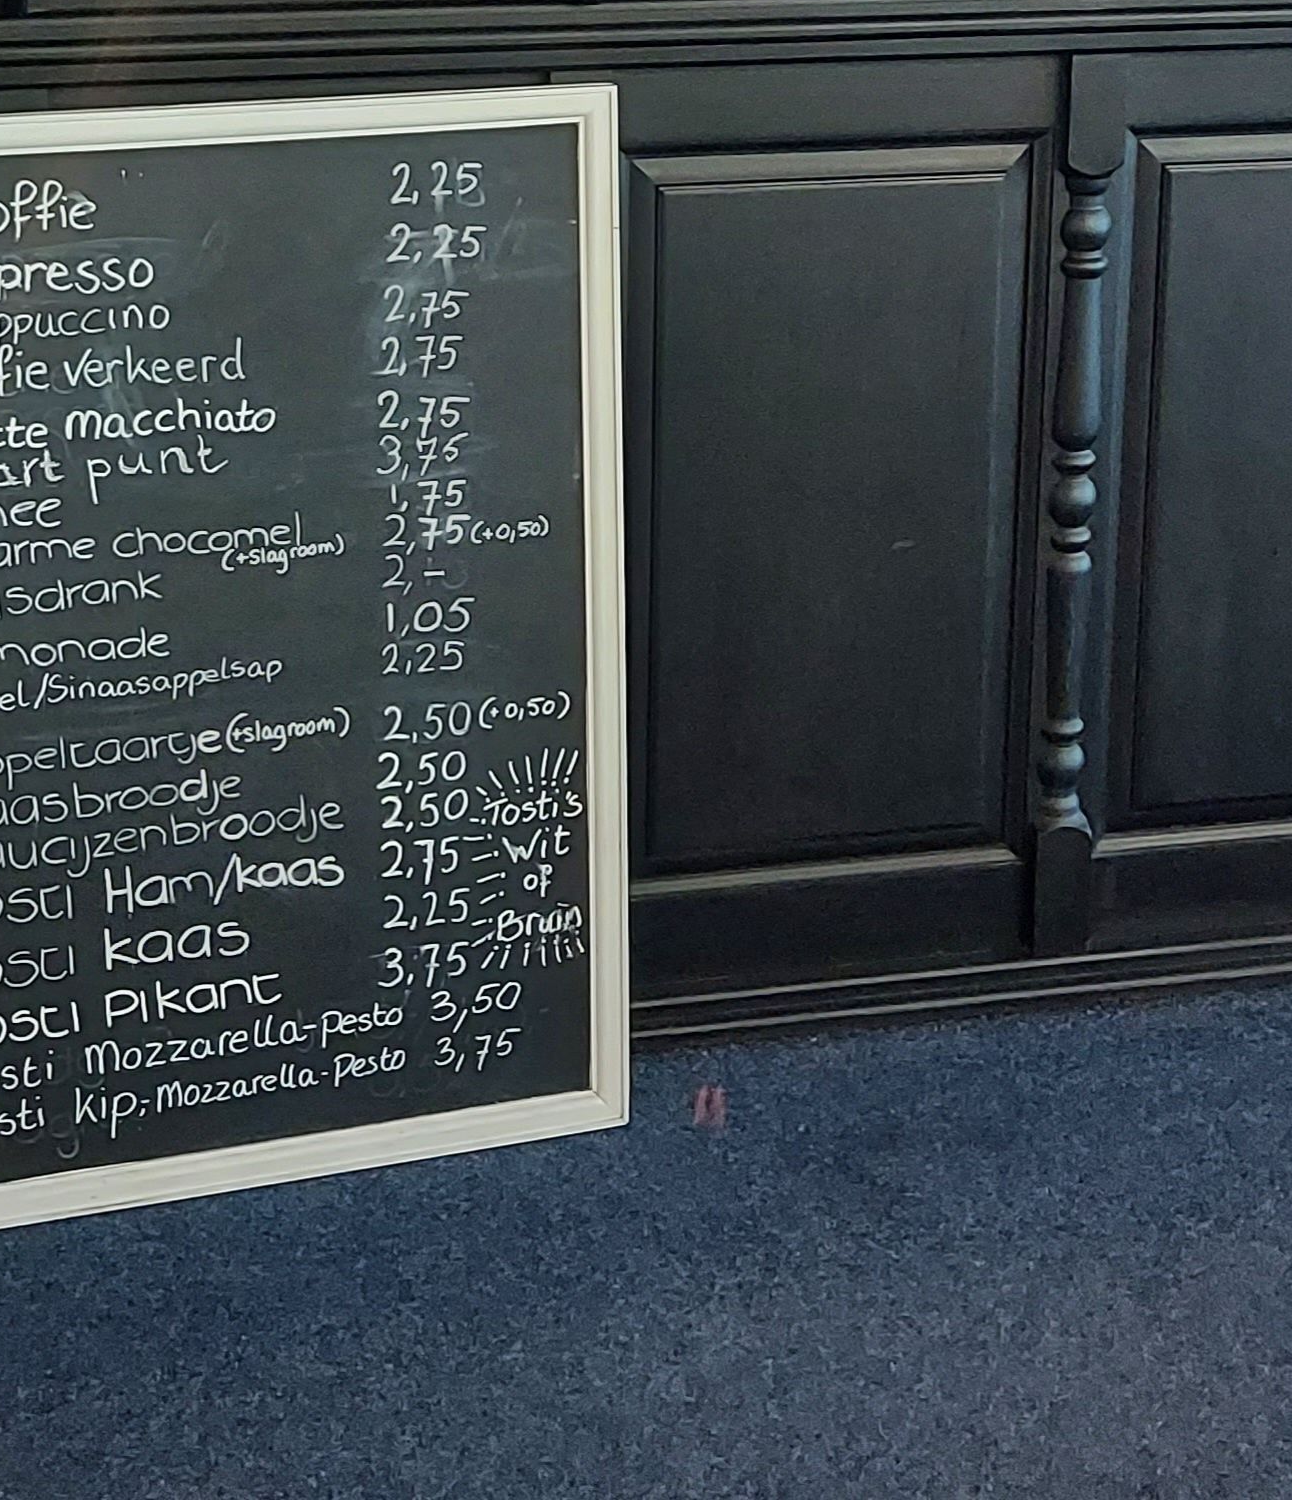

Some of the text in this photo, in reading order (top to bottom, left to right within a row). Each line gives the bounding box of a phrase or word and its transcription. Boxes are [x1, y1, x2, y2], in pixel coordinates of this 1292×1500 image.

[390, 160, 483, 205] 2,25
[386, 223, 488, 264] 2,25
[383, 284, 470, 329] 2,75
[379, 335, 464, 378] 2,75
[376, 389, 471, 438] 2,75
[87, 435, 228, 504] punt
[376, 432, 468, 482] 3,75
[390, 479, 468, 516] 1,75
[112, 511, 302, 555] chocomel
[386, 597, 475, 638] 1,05
[381, 640, 465, 675] 2,25
[383, 701, 471, 743] 2,50
[376, 750, 467, 794] 2,50
[380, 788, 469, 832] 2,50
[380, 836, 459, 886] 2,75
[522, 863, 553, 898] of
[383, 887, 470, 930] 2,25
[377, 941, 470, 988] 3,75
[430, 981, 522, 1033] 3,50
[434, 1028, 522, 1072] 3,75
